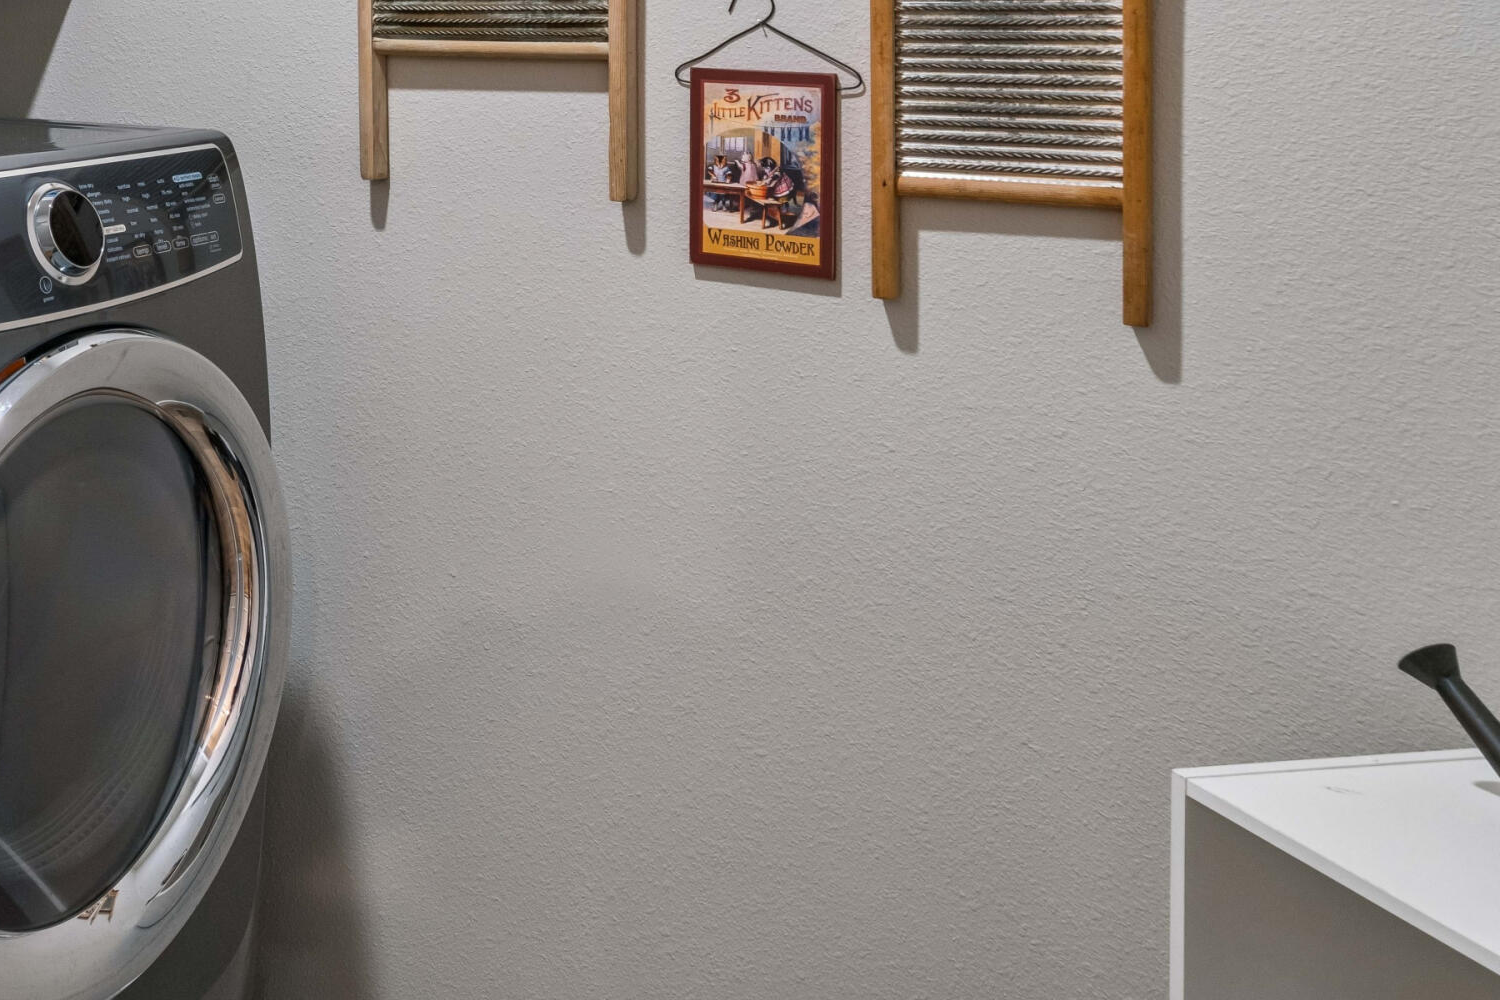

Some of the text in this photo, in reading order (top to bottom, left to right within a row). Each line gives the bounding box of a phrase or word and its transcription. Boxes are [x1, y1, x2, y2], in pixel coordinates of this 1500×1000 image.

[724, 88, 740, 103] 3
[712, 93, 813, 121] LITTLE KITTENS
[774, 114, 807, 123] BRAND
[707, 228, 815, 256] WASHING POWDER
